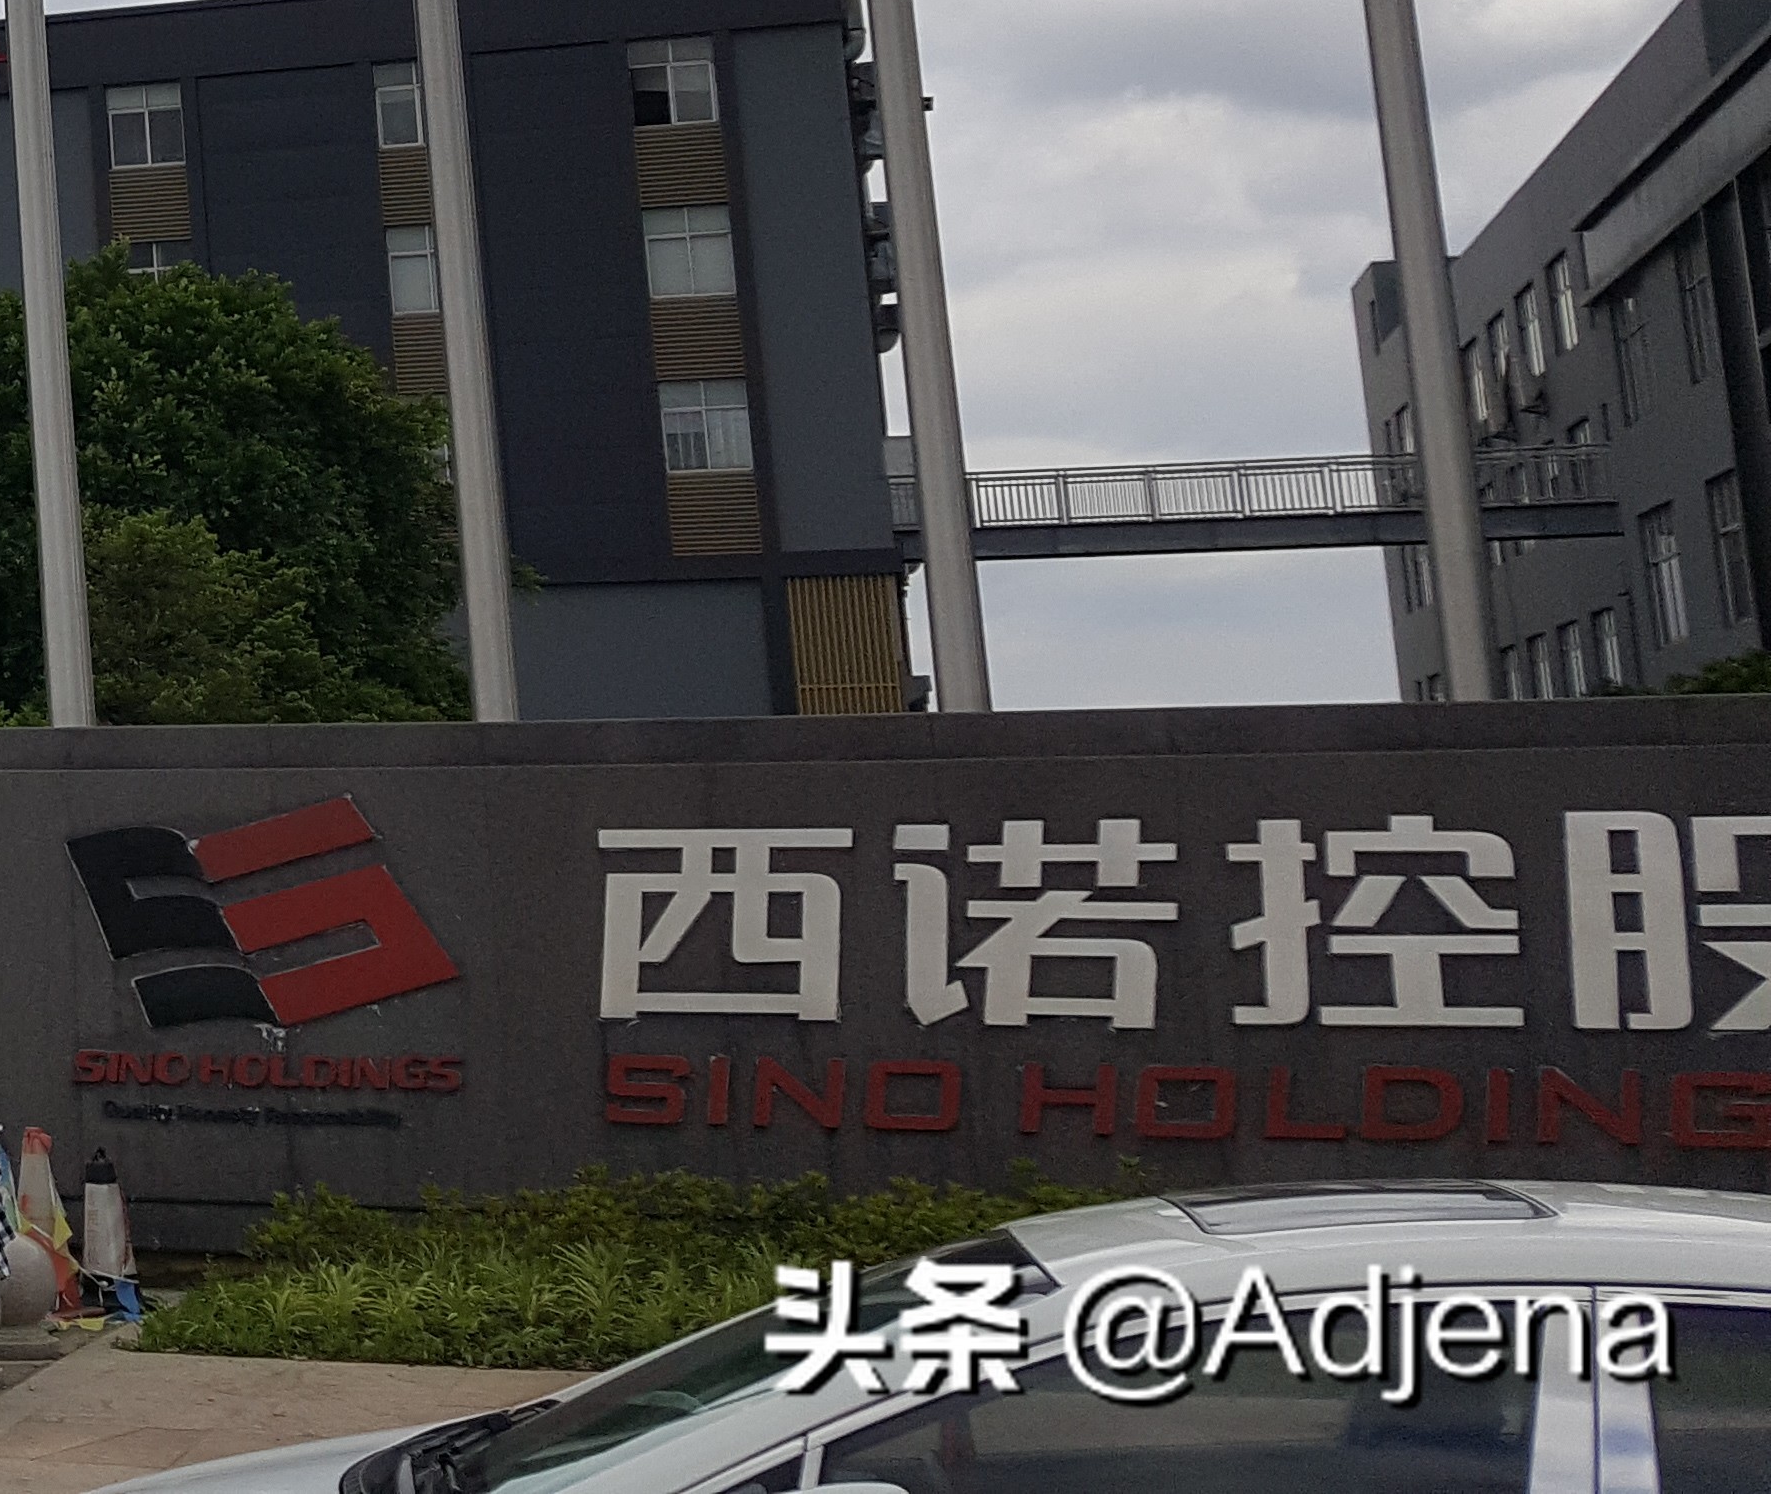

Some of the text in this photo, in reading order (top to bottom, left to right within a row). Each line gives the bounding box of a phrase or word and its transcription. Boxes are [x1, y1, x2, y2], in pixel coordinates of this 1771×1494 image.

[597, 810, 1771, 1031] 西诺控股
[73, 1048, 463, 1091] SINO HOLDINGS
[604, 1053, 961, 1132] SINO
